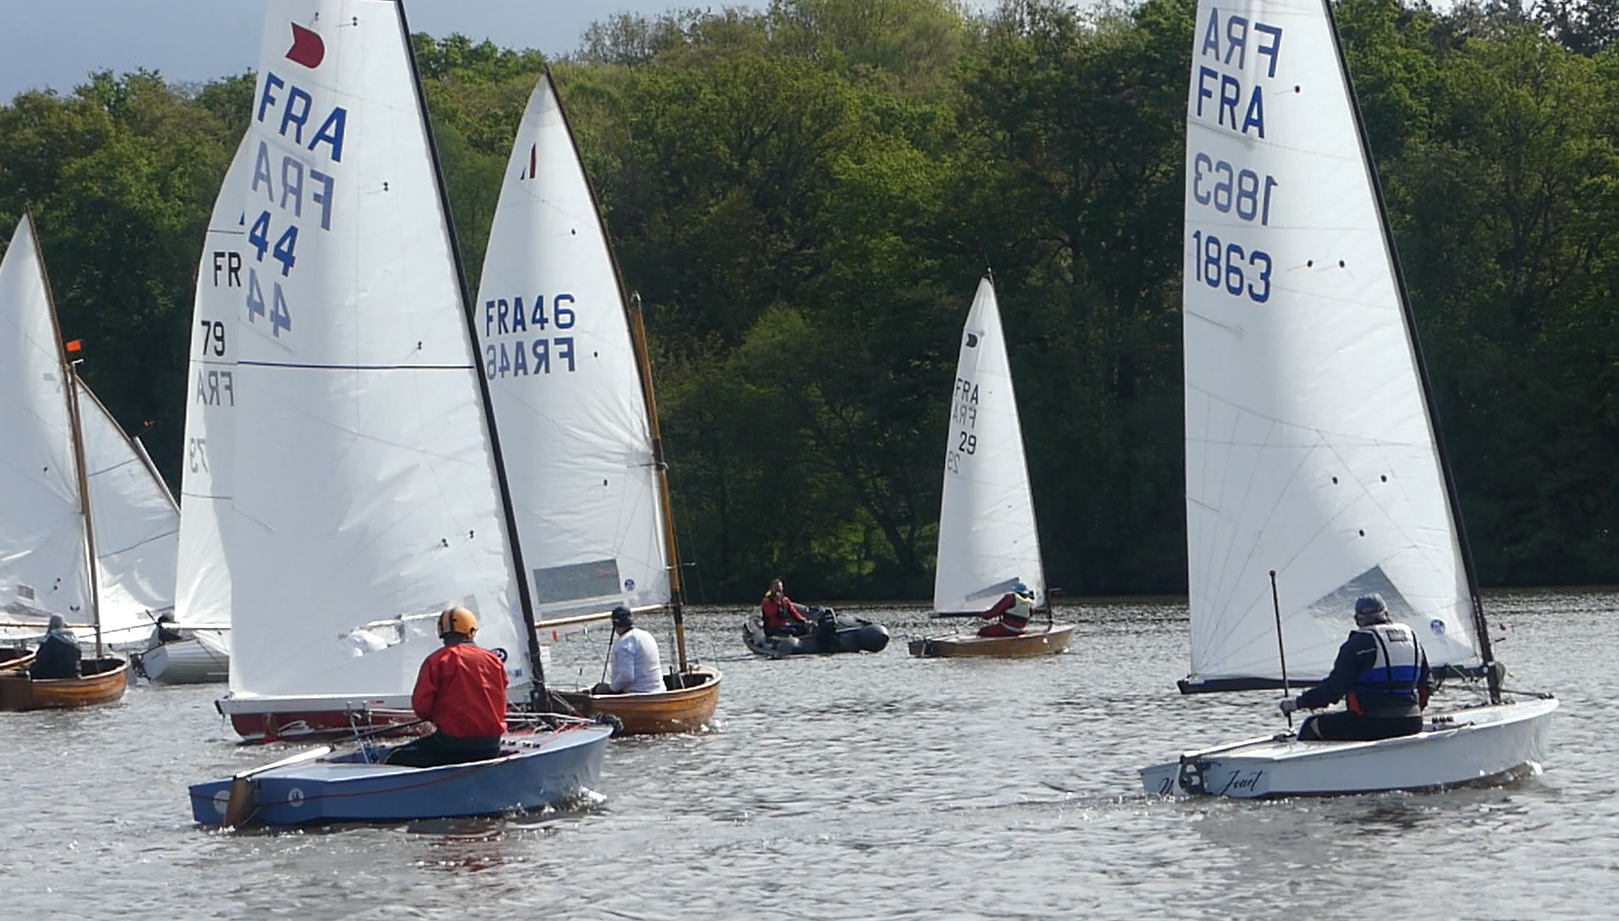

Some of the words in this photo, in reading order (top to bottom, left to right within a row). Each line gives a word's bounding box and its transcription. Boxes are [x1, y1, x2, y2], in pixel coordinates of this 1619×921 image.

[256, 71, 347, 163] FRA
[1197, 65, 1265, 138] FRA
[248, 210, 298, 277] 44
[213, 252, 241, 287] FR
[1193, 230, 1272, 303] 1863
[486, 294, 575, 337] FRA46
[200, 320, 226, 356] 79
[954, 378, 979, 405] FRA
[959, 431, 977, 455] 29
